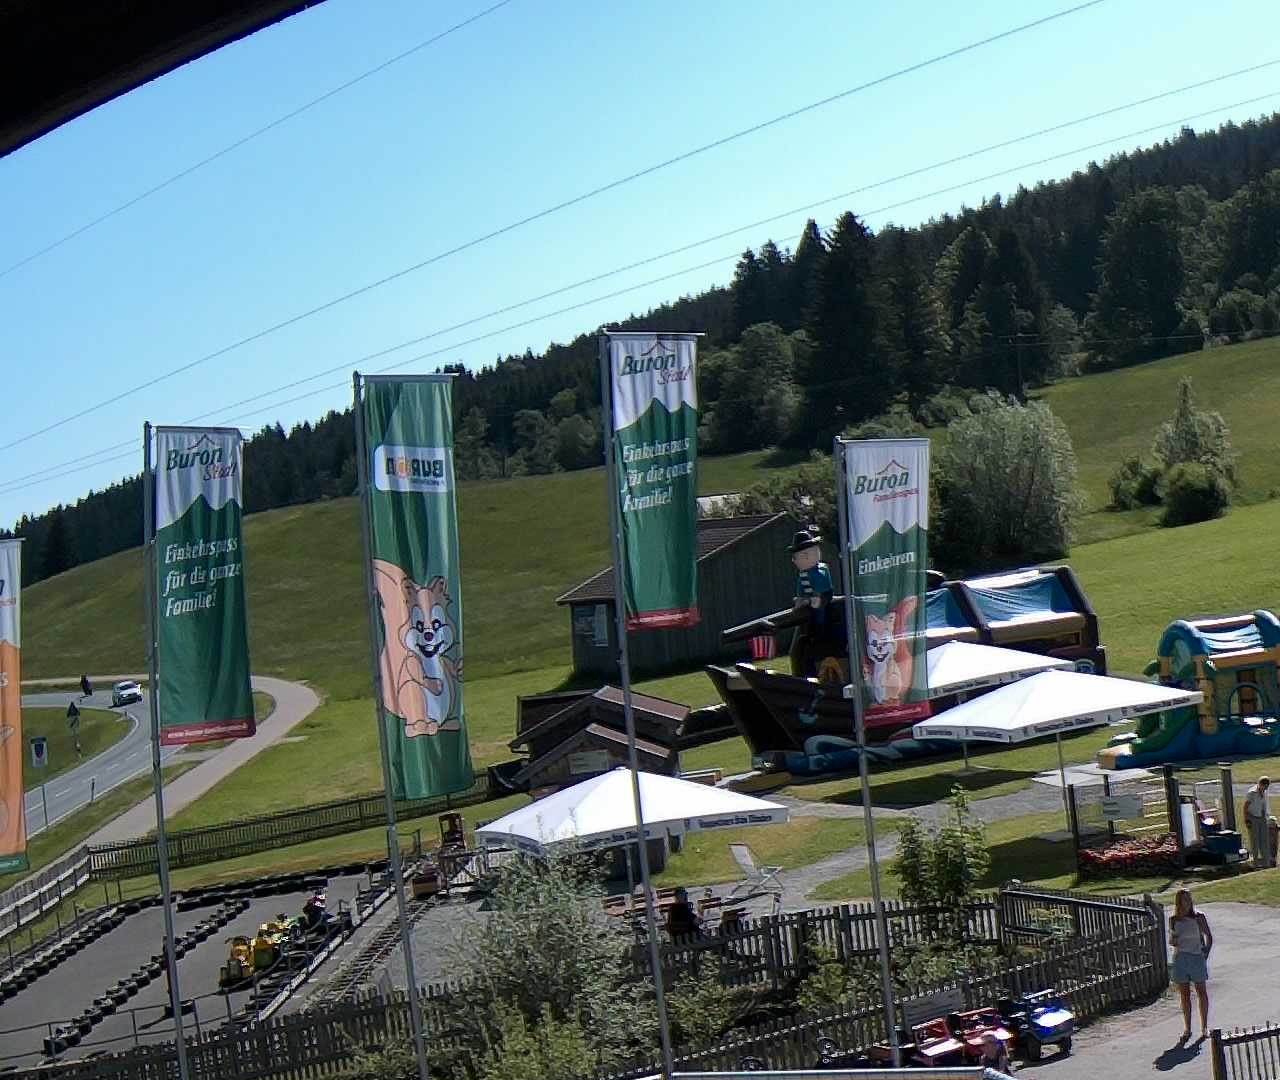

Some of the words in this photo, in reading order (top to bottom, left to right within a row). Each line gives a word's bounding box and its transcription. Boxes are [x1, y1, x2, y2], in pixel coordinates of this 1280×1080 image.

[620, 353, 676, 376] Buron
[167, 447, 222, 472] Buron
[854, 471, 910, 495] Buron
[858, 552, 914, 575] Einkehren
[162, 570, 187, 597] für
[166, 588, 217, 617] Familie!
